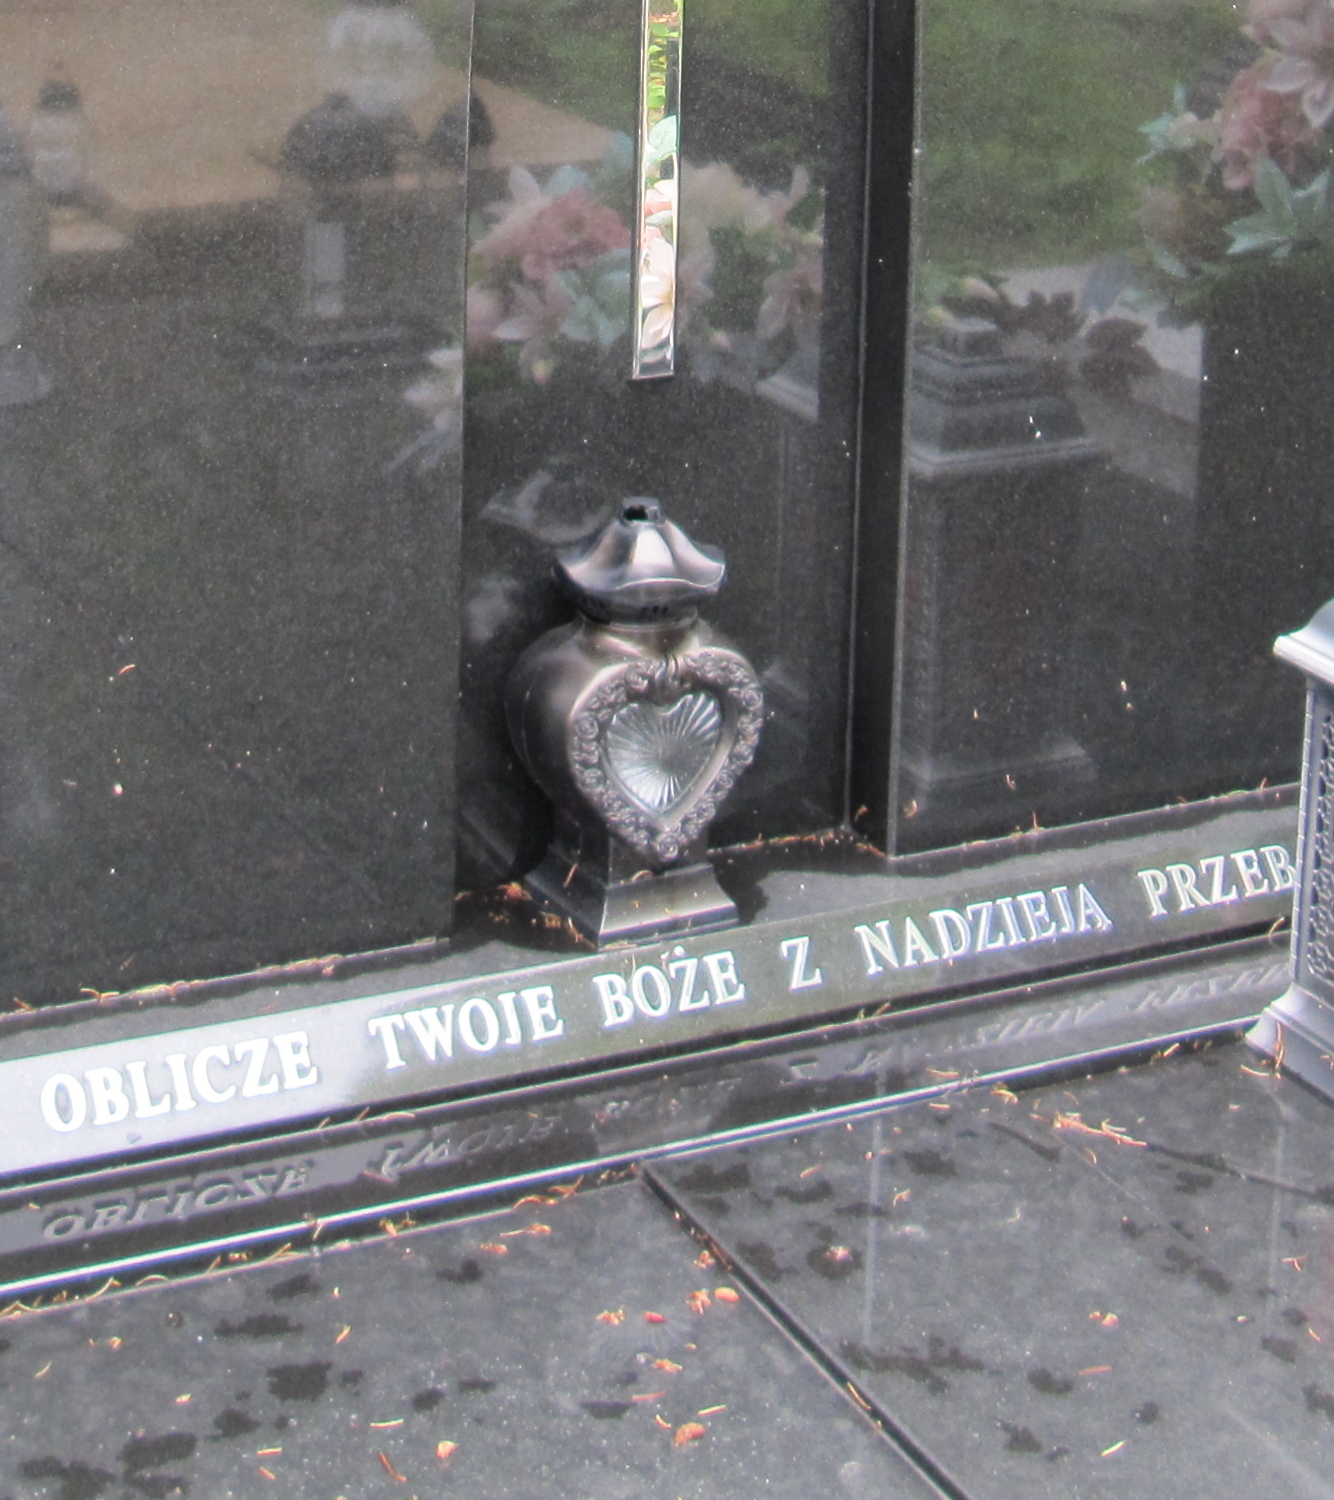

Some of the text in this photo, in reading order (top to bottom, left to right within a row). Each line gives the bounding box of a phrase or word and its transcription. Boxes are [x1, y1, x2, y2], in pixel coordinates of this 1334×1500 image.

[40, 1031, 319, 1133] OBLICZE
[367, 985, 564, 1070] TWOJE
[593, 945, 746, 1028] BOŻE
[780, 936, 823, 992] Z
[1138, 844, 1298, 918] PRZEB
